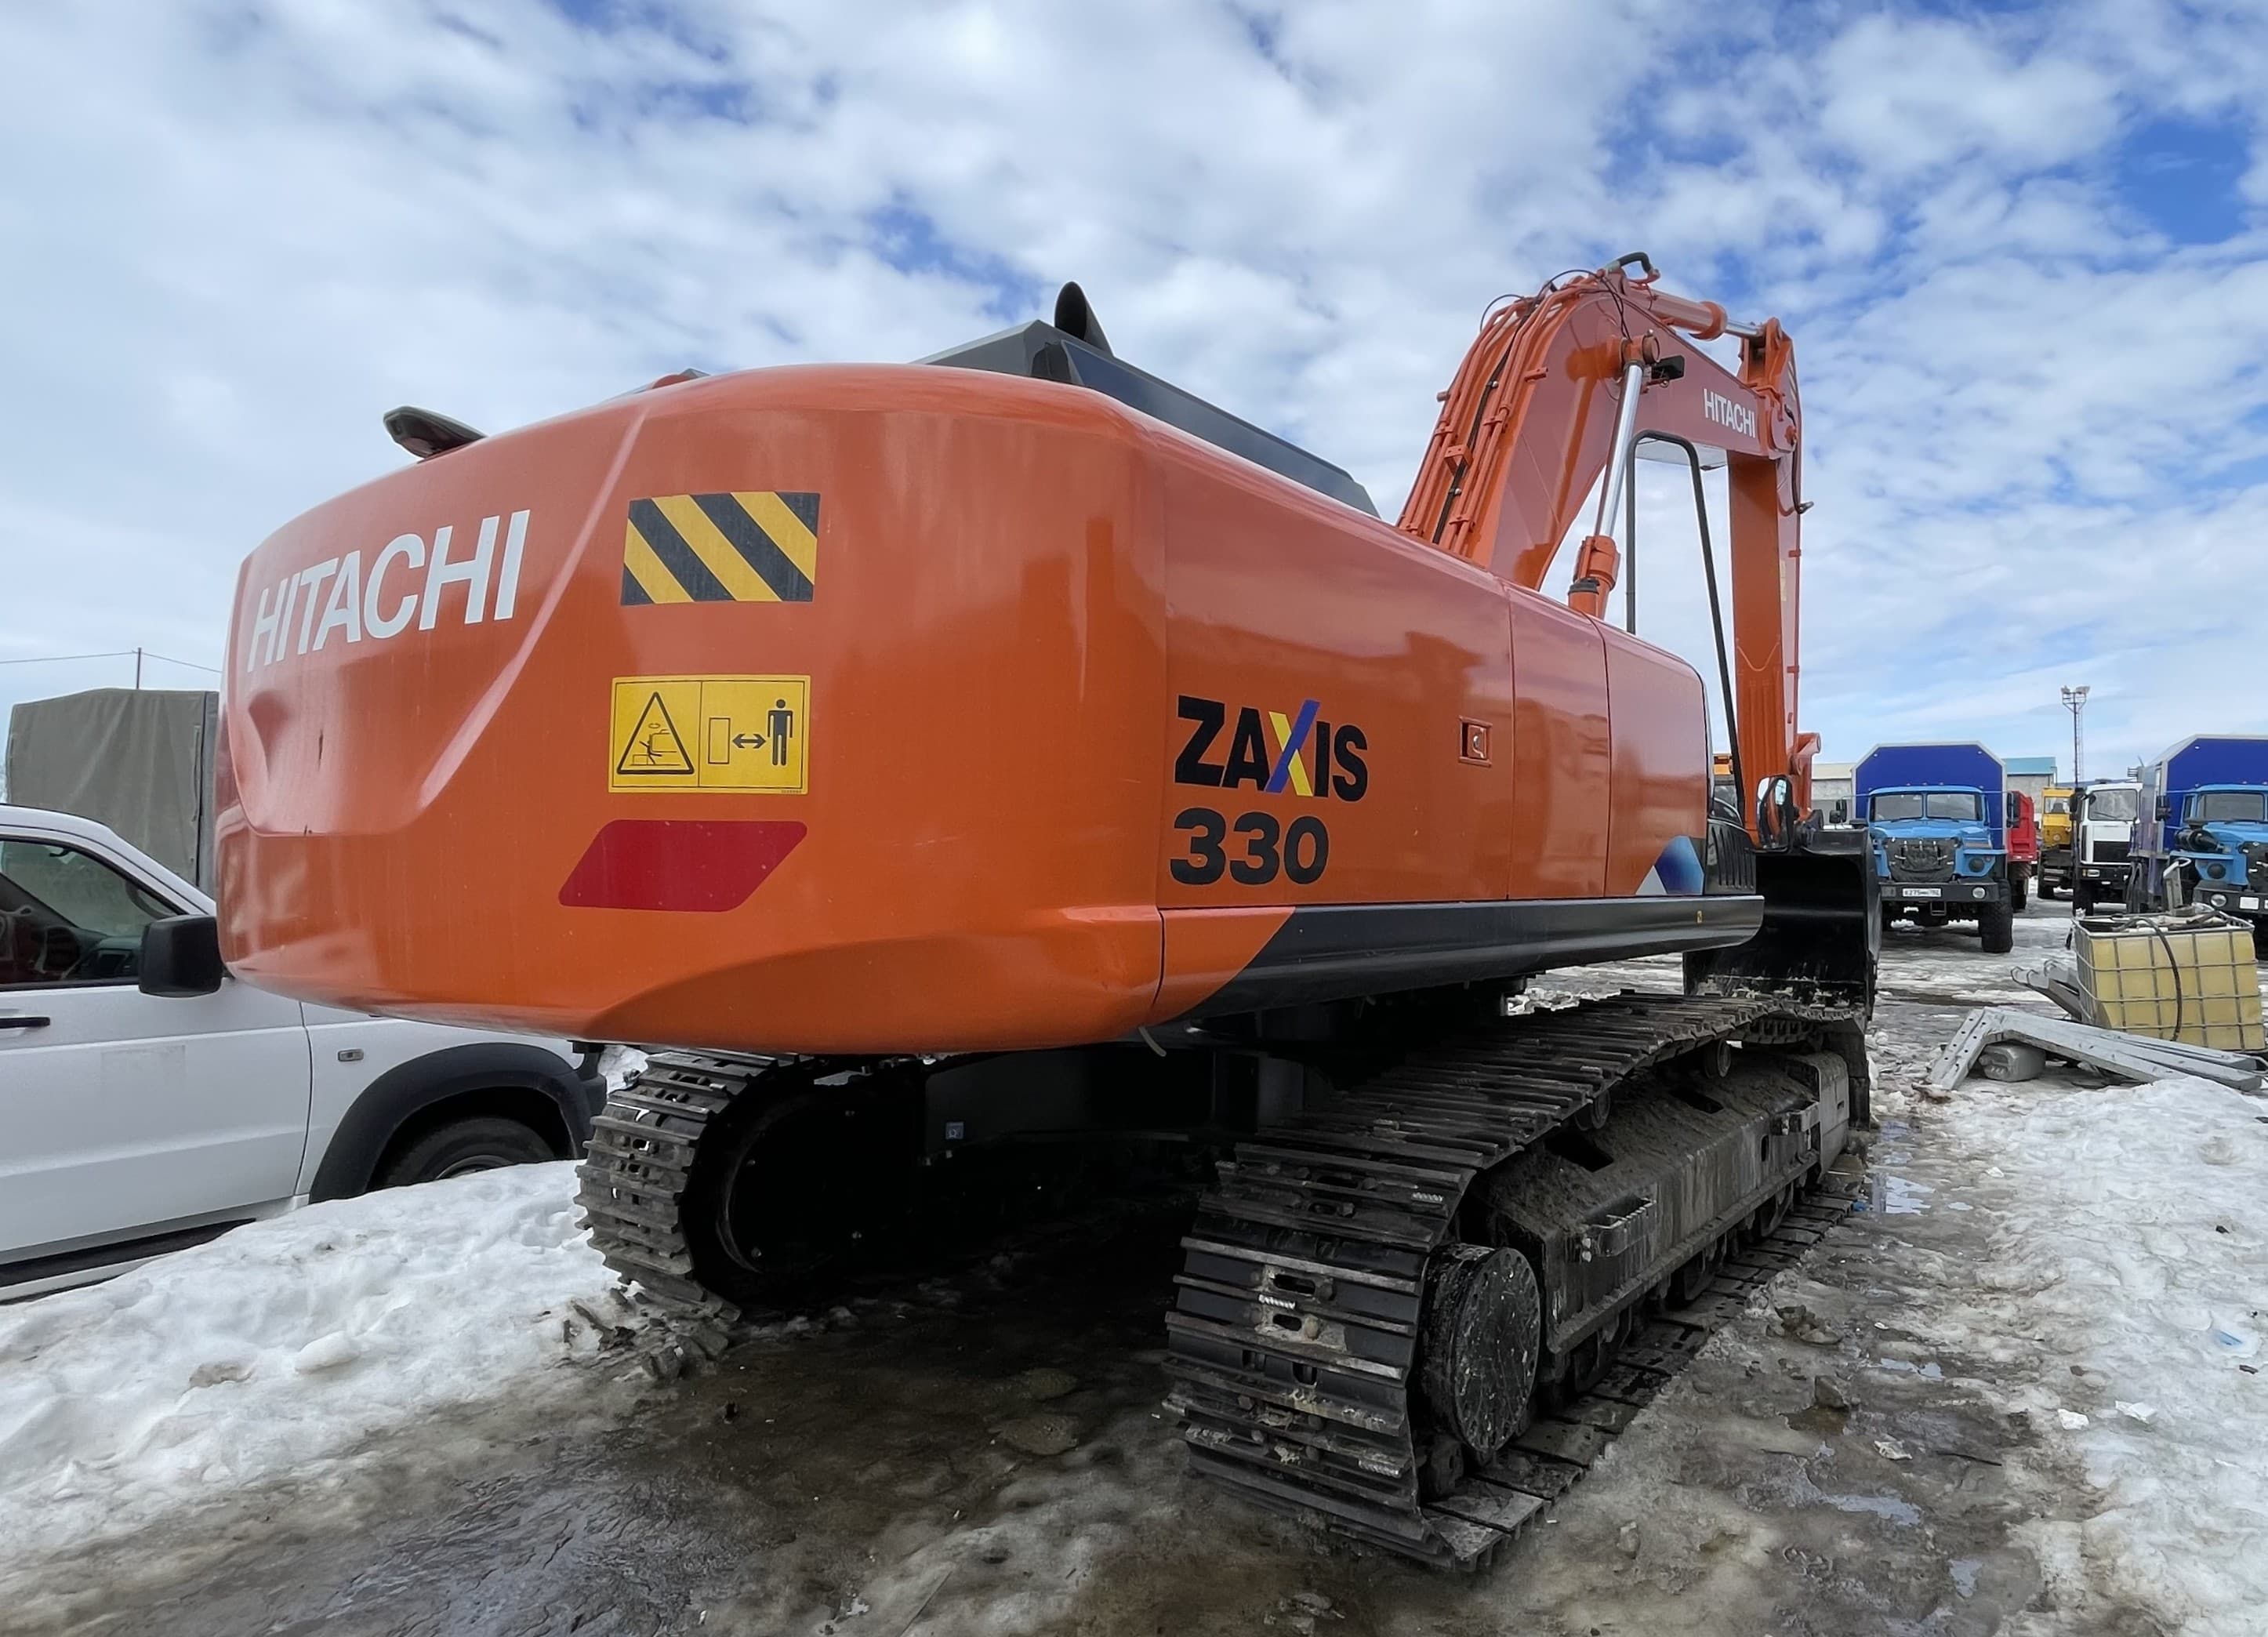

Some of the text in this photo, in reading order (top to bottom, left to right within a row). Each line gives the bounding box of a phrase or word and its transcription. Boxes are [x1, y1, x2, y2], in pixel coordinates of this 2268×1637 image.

[1704, 388, 1755, 438] HITACHI
[246, 509, 531, 673] HITACHI
[1174, 695, 1368, 802] ZAXIS
[1170, 807, 1330, 885] 330
